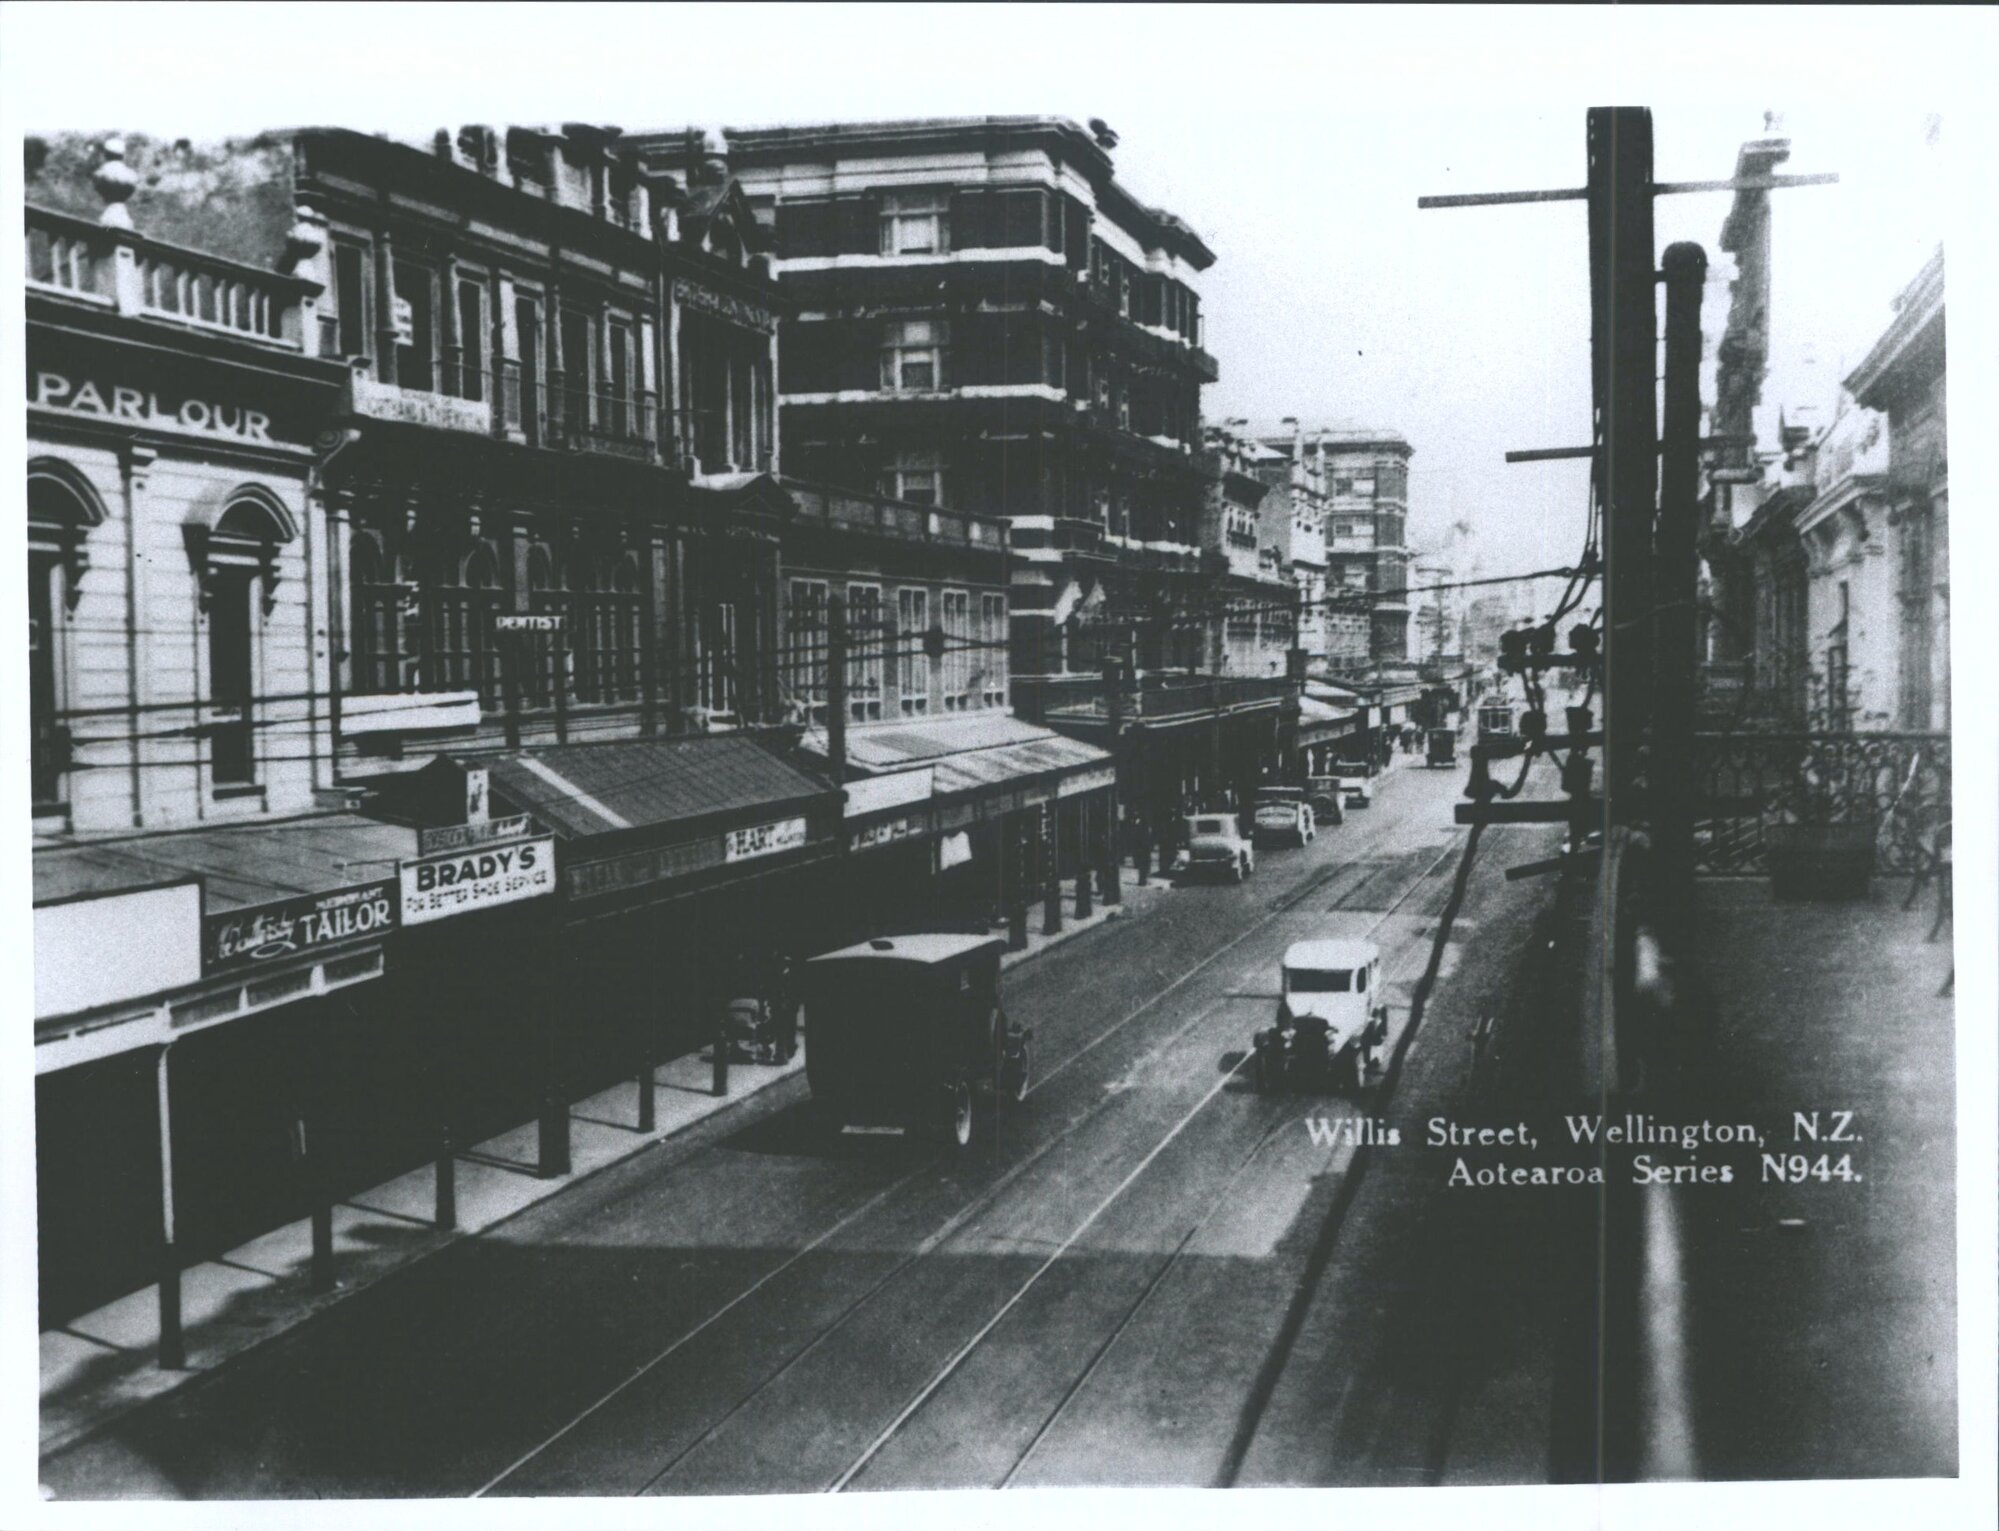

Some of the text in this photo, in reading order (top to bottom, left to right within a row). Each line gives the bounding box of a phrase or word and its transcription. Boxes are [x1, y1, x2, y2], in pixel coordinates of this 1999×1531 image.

[36, 371, 273, 443] PARLOUR
[495, 615, 563, 630] DENTIST
[416, 846, 536, 892] BRADY'S
[299, 899, 393, 944] TAILOR
